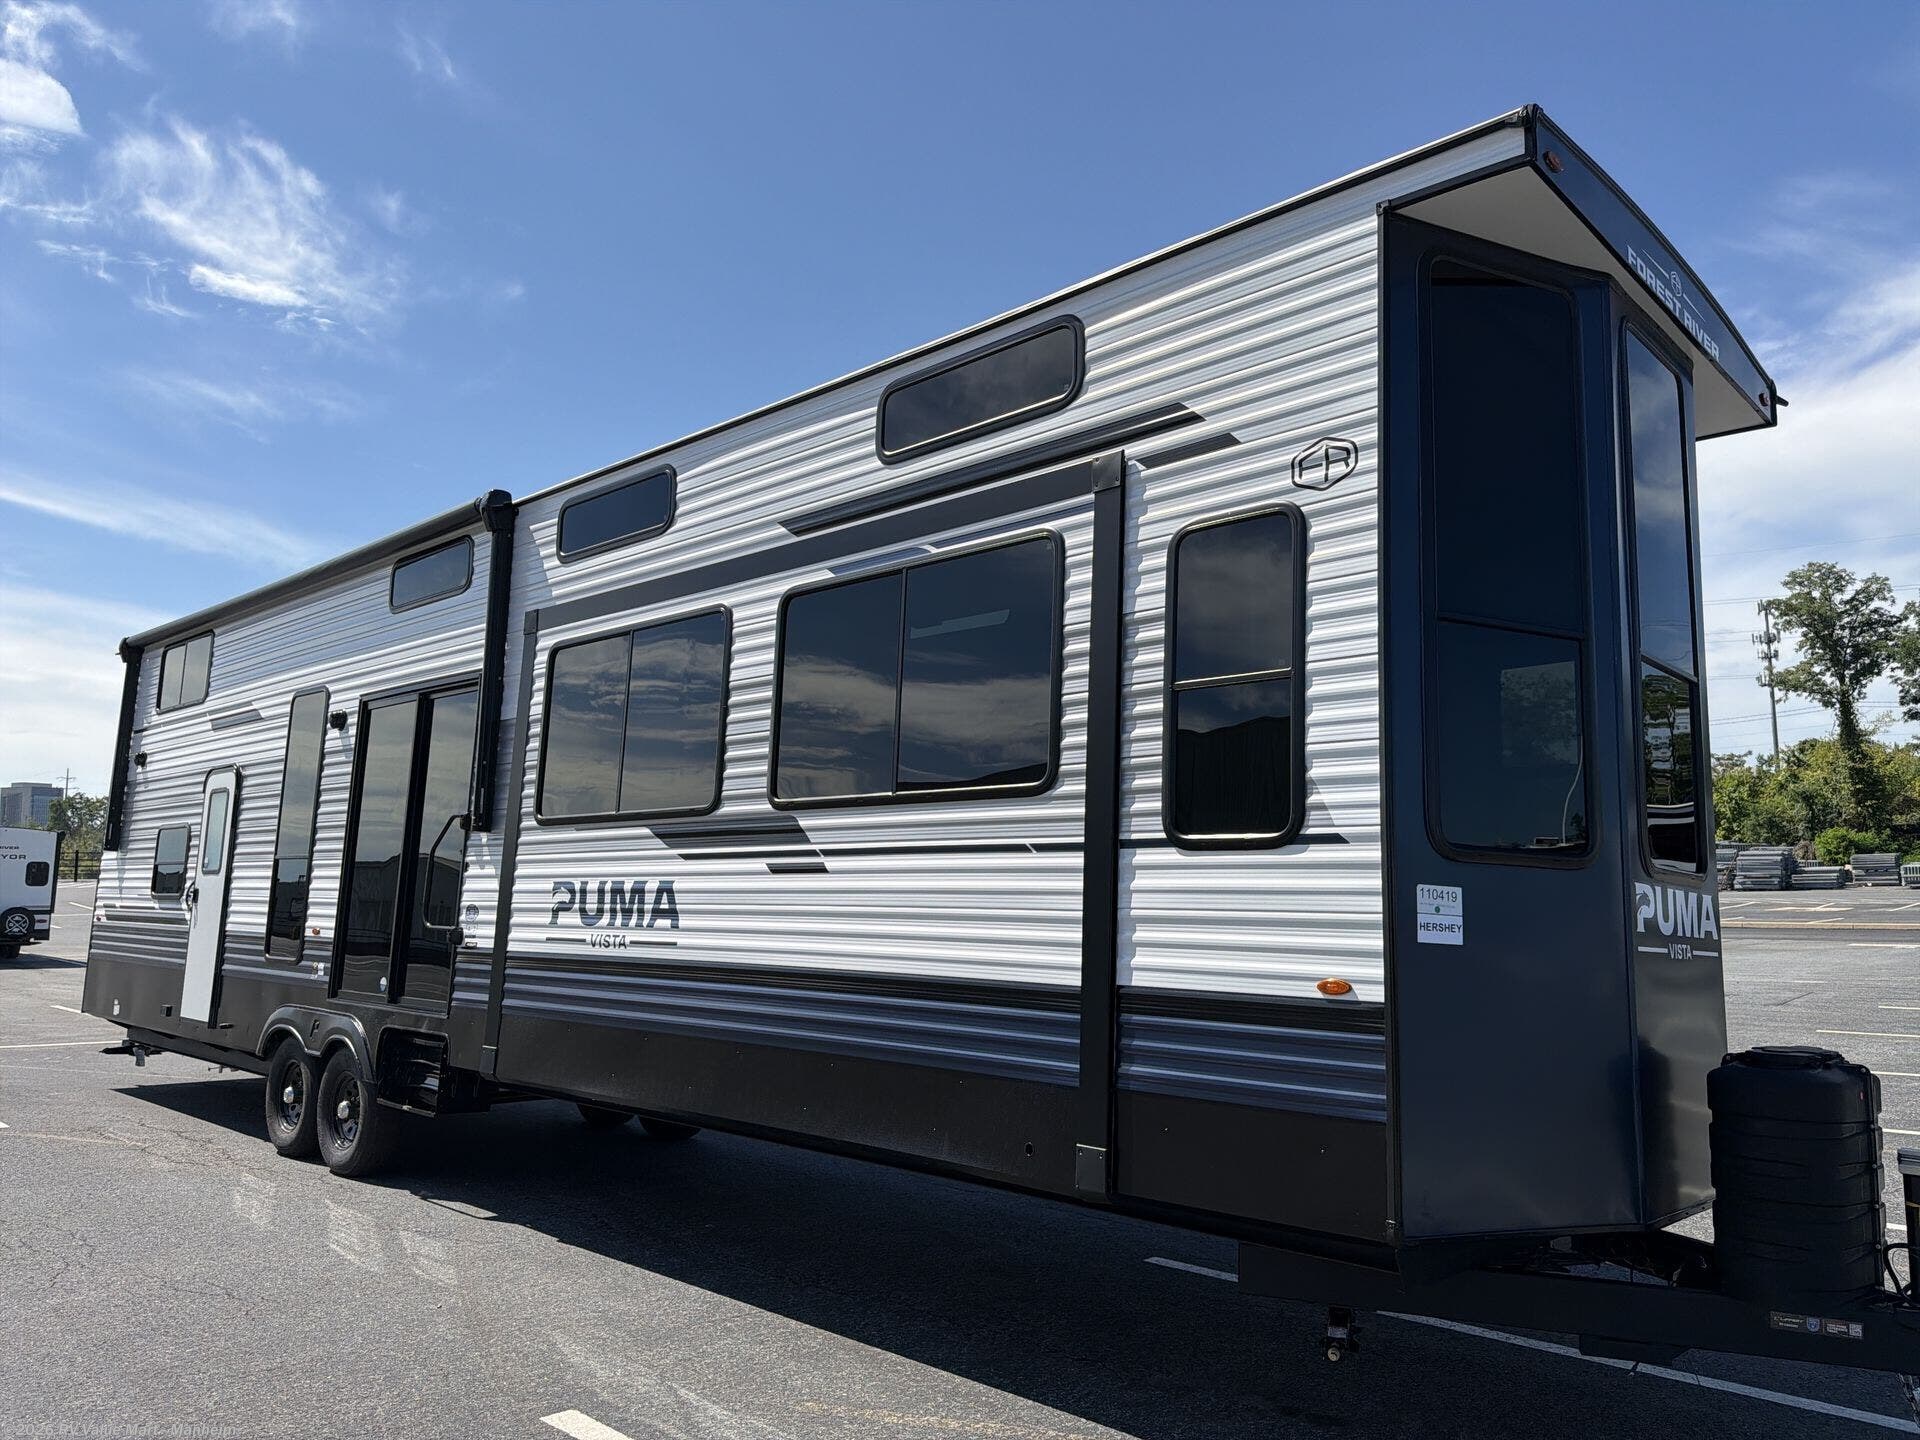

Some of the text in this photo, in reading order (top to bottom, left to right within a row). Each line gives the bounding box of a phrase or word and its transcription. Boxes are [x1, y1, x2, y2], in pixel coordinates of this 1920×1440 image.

[1627, 245, 1720, 362] FOREST RIVER
[1420, 887, 1458, 903] 110419
[549, 880, 680, 929] PUMA
[1634, 881, 1719, 940] PUMA
[1419, 921, 1463, 934] HERSHEY
[590, 934, 627, 949] VISTA
[1668, 943, 1693, 960] VISTA
